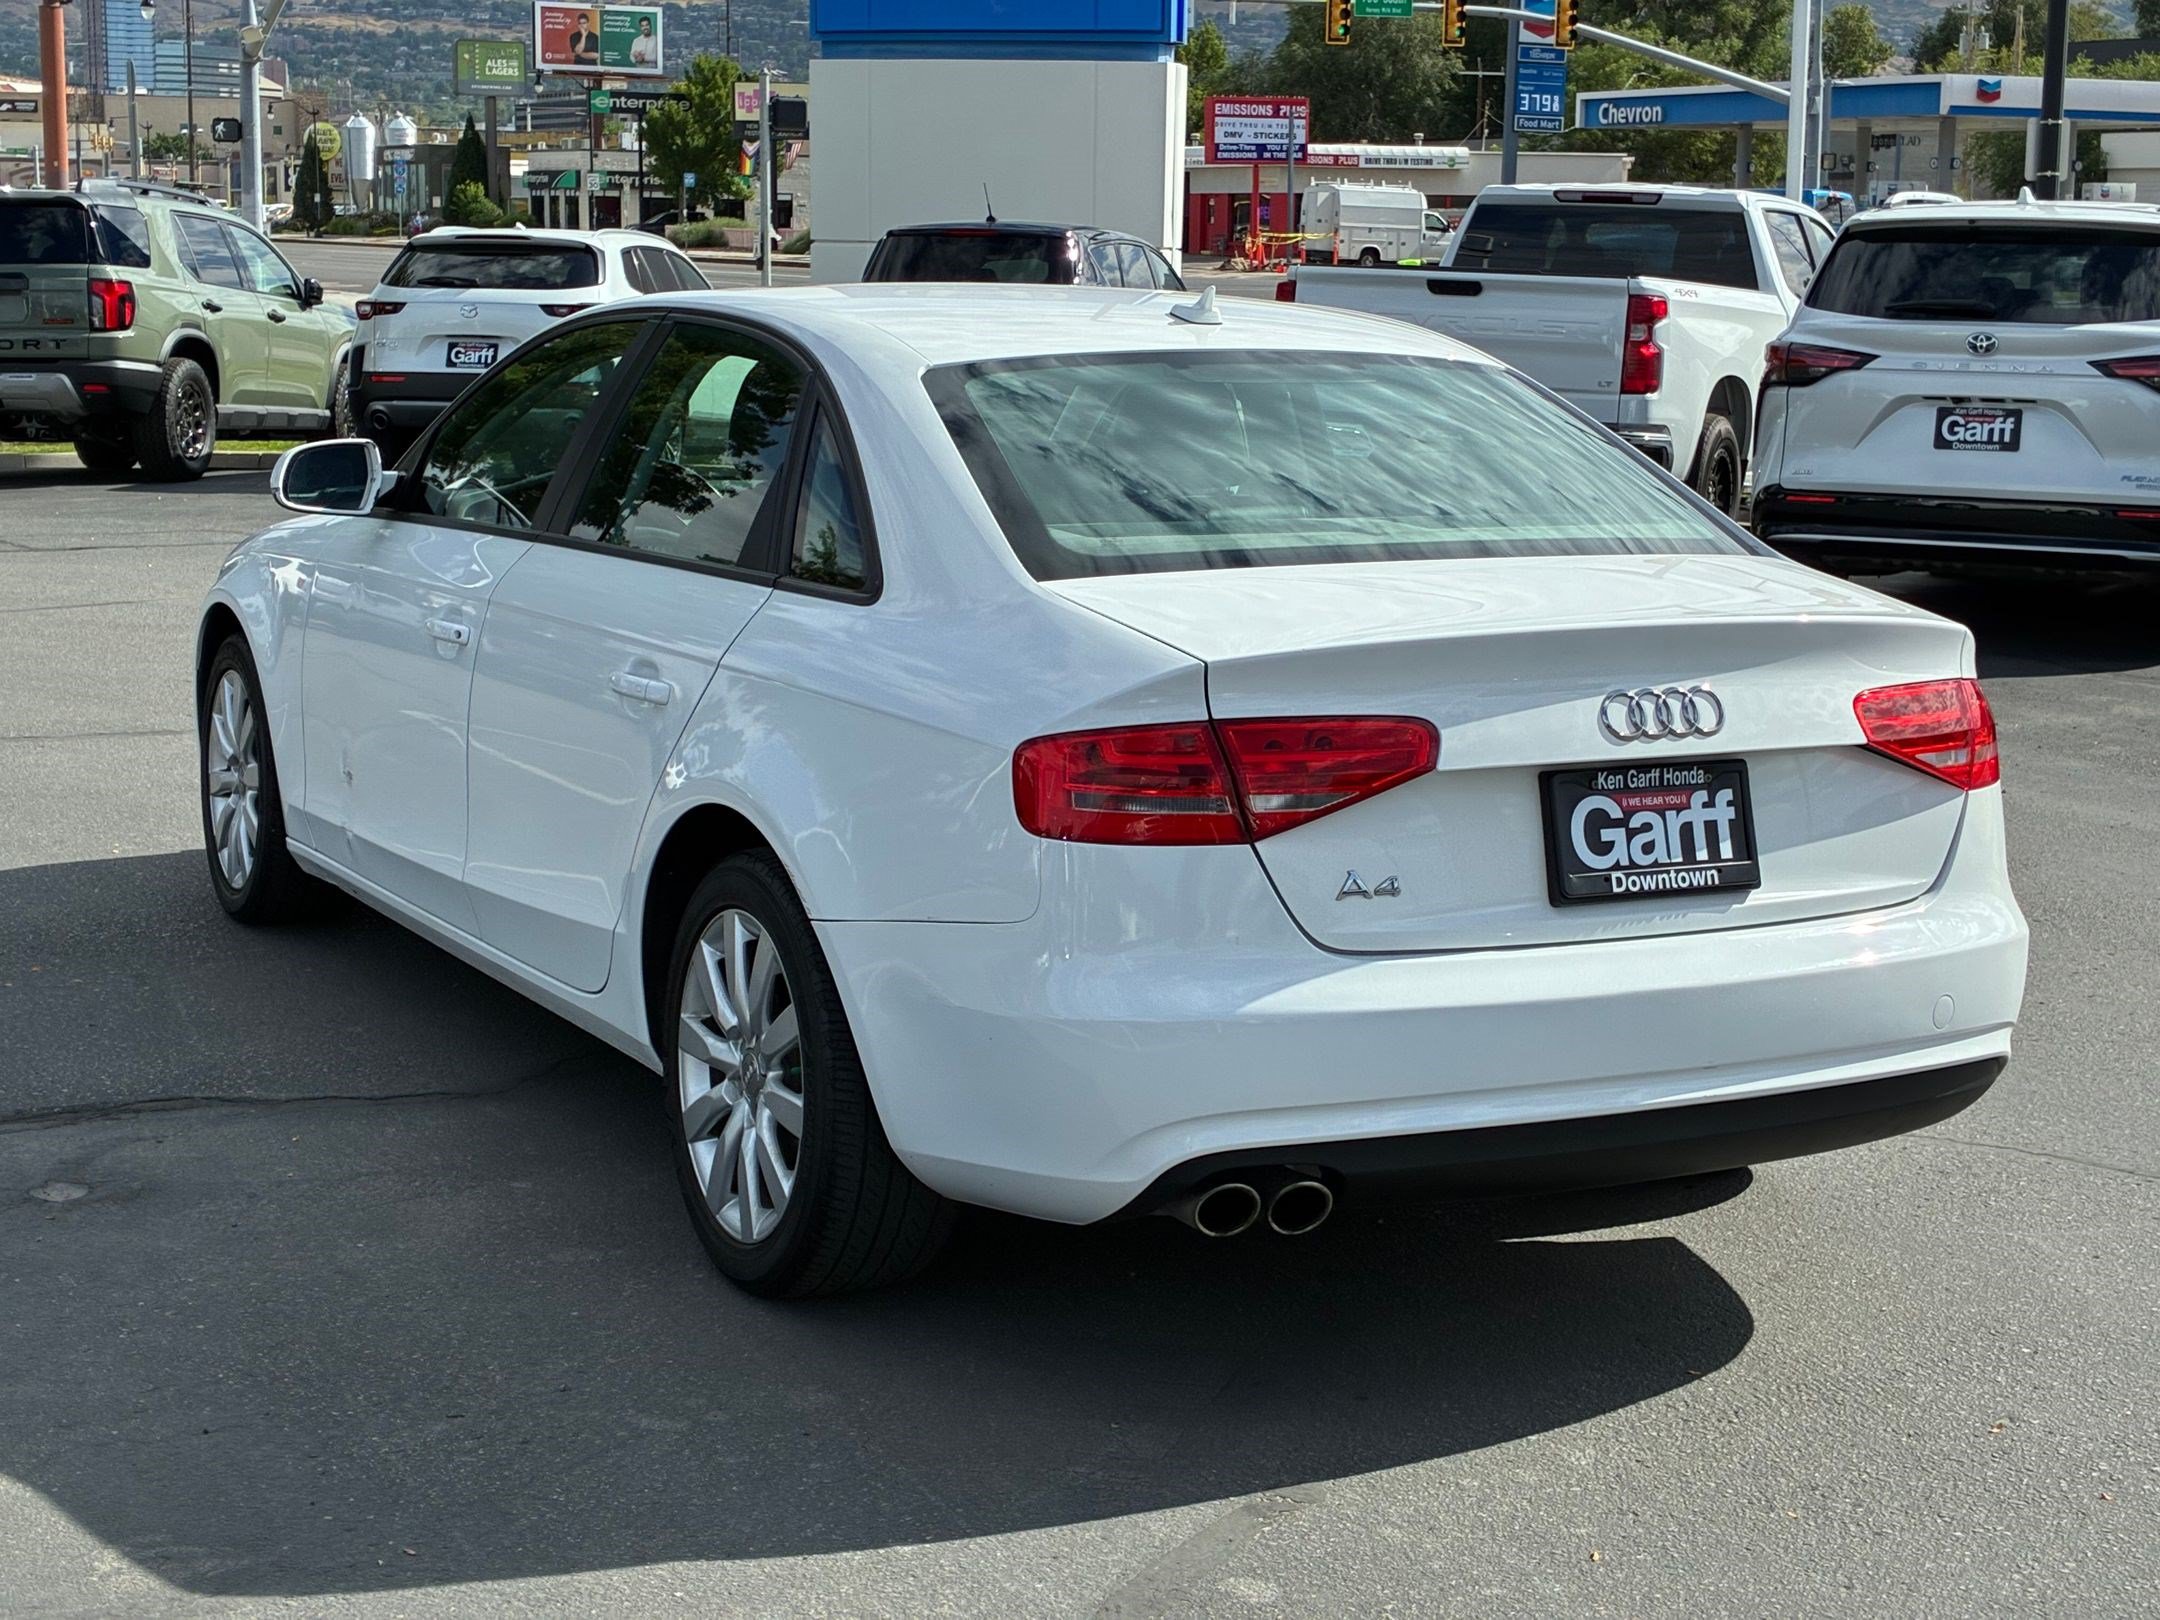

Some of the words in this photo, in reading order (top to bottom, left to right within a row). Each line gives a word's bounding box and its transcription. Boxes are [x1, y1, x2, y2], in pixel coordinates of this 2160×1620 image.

[486, 59, 507, 67] ALES
[486, 67, 518, 76] LAGERS
[1214, 104, 1274, 116] EMISSIONS
[1598, 102, 1662, 124] Chevron
[1519, 118, 1538, 128] Food
[1540, 120, 1560, 128] Mart
[1338, 156, 1358, 166] PLUS
[450, 346, 494, 364] Garff
[1910, 361, 2054, 374] SIENNA
[1941, 415, 2015, 443] Garff
[1952, 442, 2000, 450] Downtown
[1597, 771, 1624, 790] Ken
[1628, 768, 1661, 788] Garff
[1663, 766, 1705, 787] Honda
[1628, 798, 1642, 807] WE
[1644, 797, 1664, 806] HEAR
[1666, 796, 1680, 805] YOU
[1570, 788, 1736, 870] Garff
[1335, 868, 1402, 901] A4
[1611, 868, 1719, 893] Downtown
